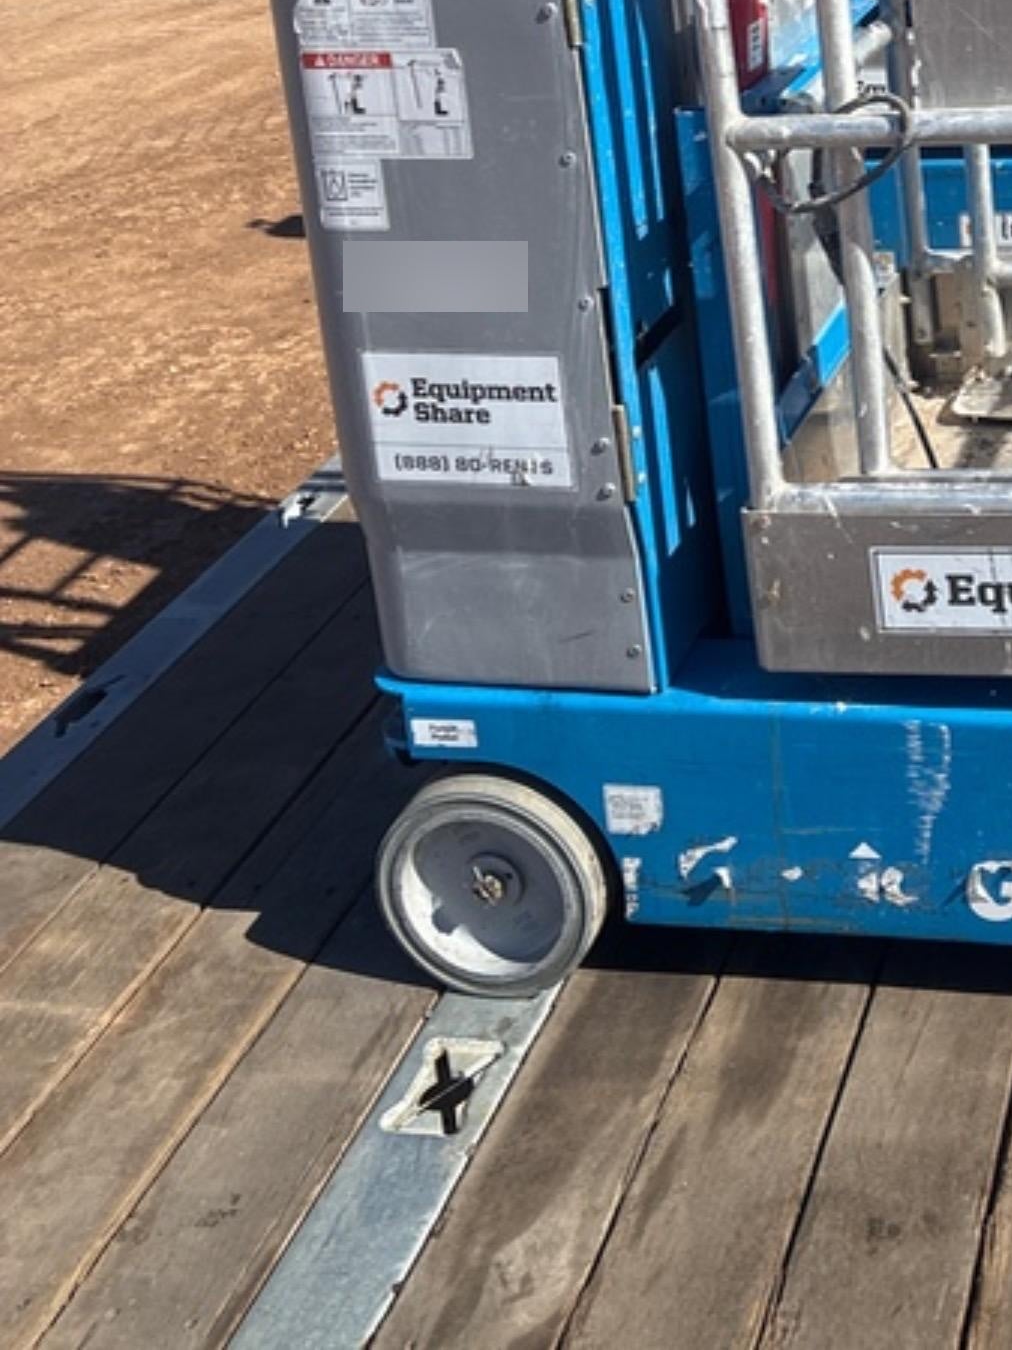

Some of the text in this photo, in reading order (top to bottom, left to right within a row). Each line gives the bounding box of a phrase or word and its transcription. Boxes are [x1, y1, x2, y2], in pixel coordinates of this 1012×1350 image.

[410, 377, 557, 405] Equipment
[413, 402, 491, 424] Share
[395, 453, 450, 471] (888)
